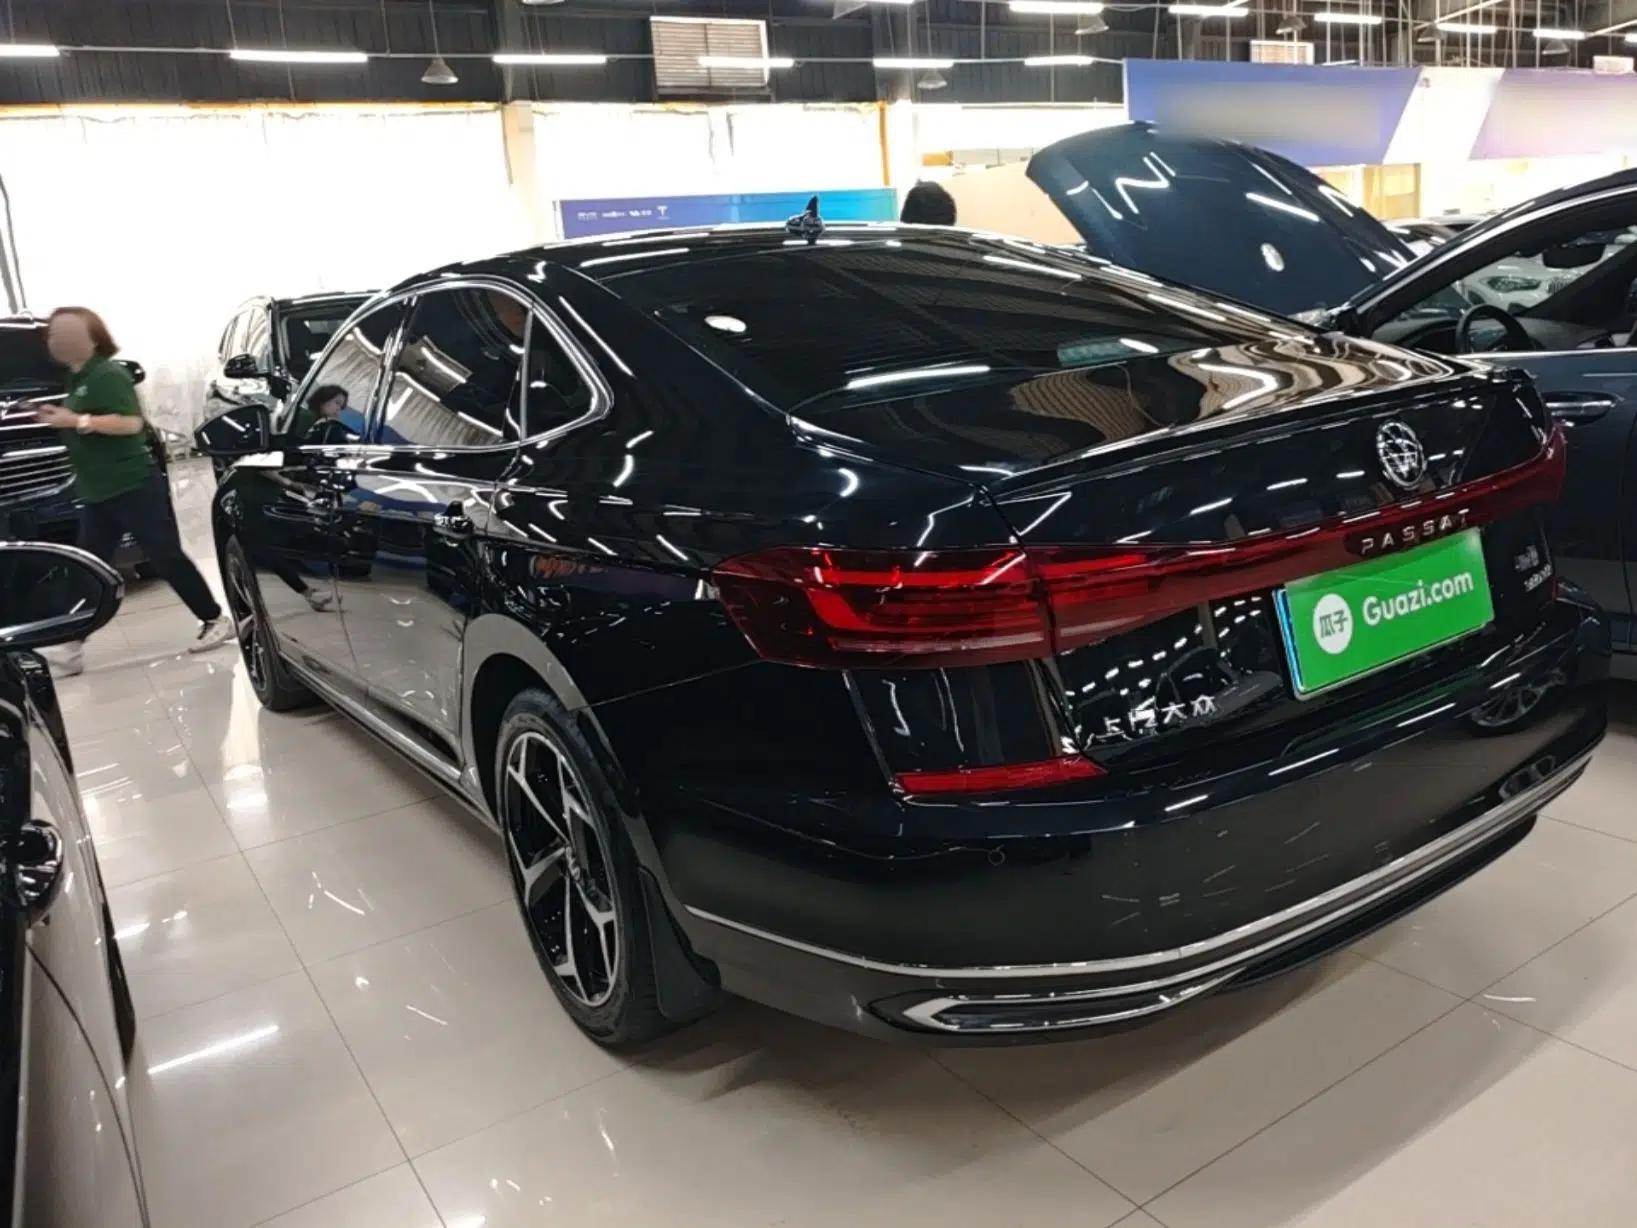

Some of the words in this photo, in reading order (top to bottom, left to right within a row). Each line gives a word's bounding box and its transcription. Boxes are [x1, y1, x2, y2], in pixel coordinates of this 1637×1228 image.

[1361, 508, 1470, 555] PASSAT
[1362, 571, 1475, 627] Guazi.com
[1319, 609, 1348, 639] 瓜子
